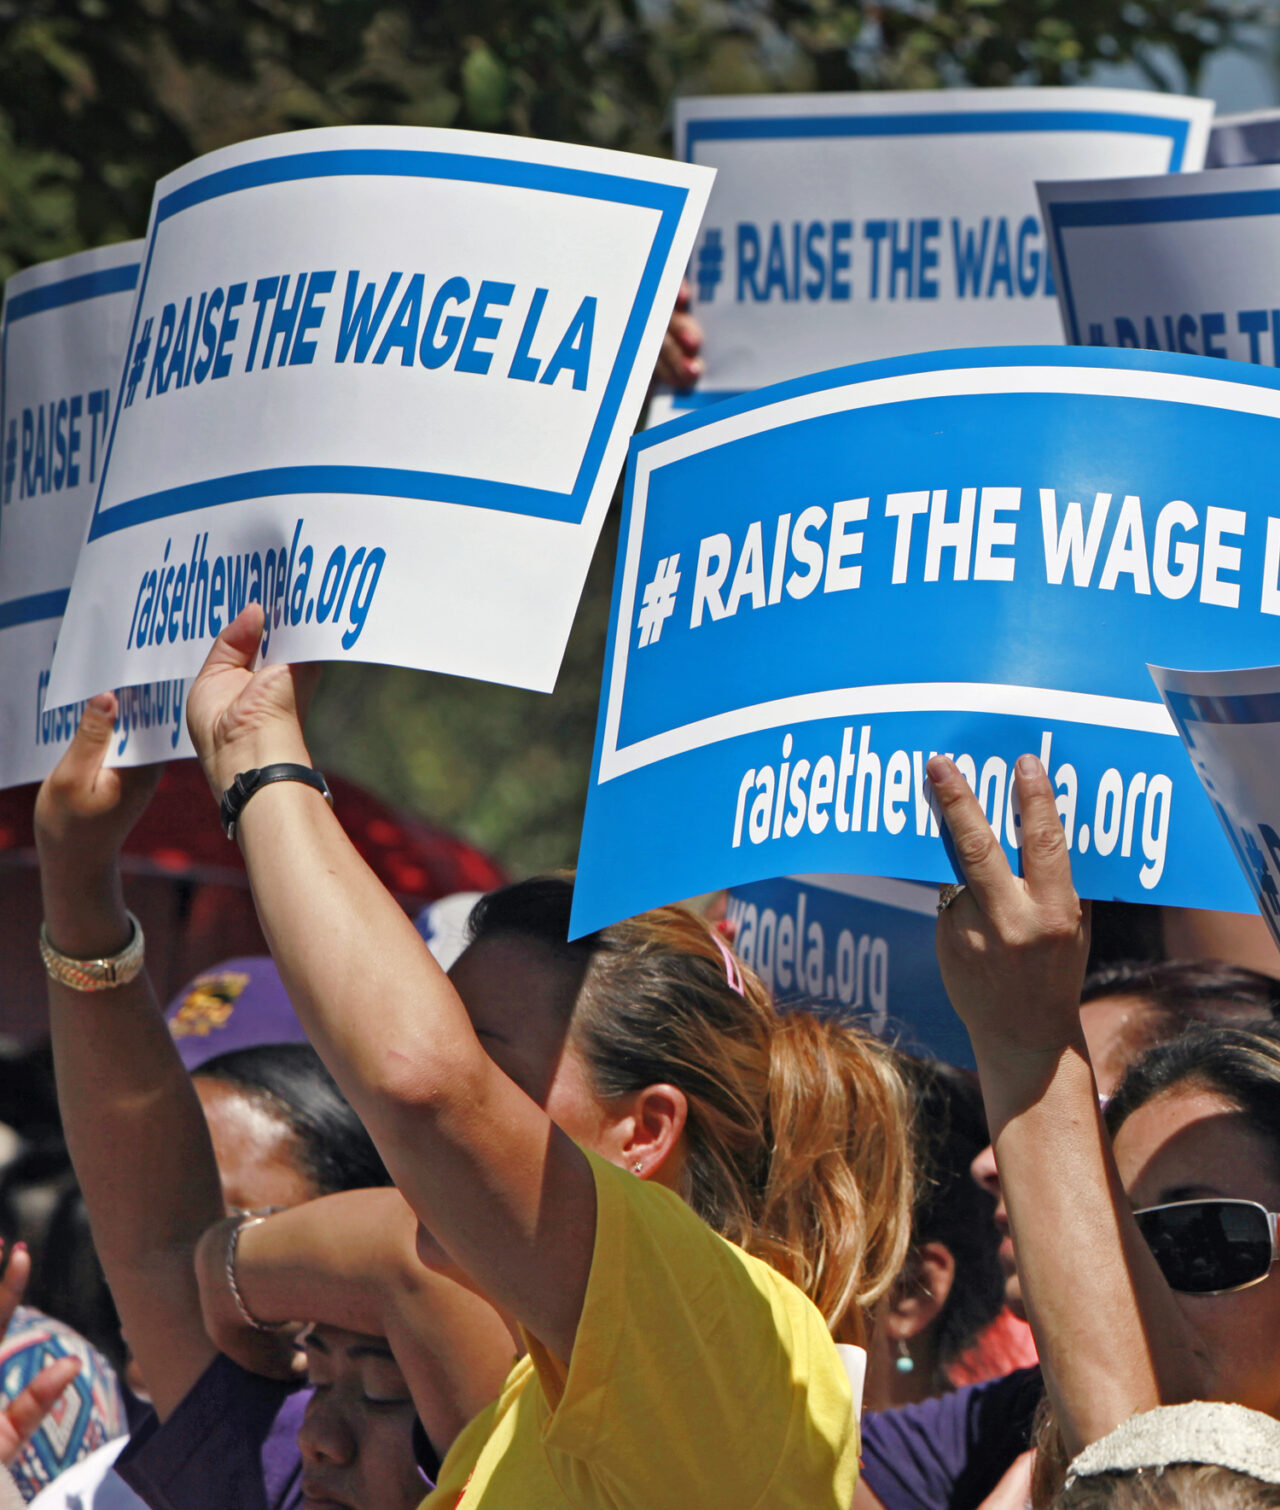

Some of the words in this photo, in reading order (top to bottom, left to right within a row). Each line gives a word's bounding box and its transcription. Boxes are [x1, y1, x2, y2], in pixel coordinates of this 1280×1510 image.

[736, 219, 853, 303] RAISE
[863, 218, 941, 302] THE
[951, 214, 1057, 300] WAG
[146, 281, 248, 400] RAISE
[245, 270, 337, 373] THE
[334, 270, 516, 375] WAGE
[507, 287, 598, 392] LA
[19, 394, 83, 501] RAISE
[690, 496, 870, 630] RAISE
[884, 487, 1022, 585] THE
[1039, 488, 1247, 609] WAGE
